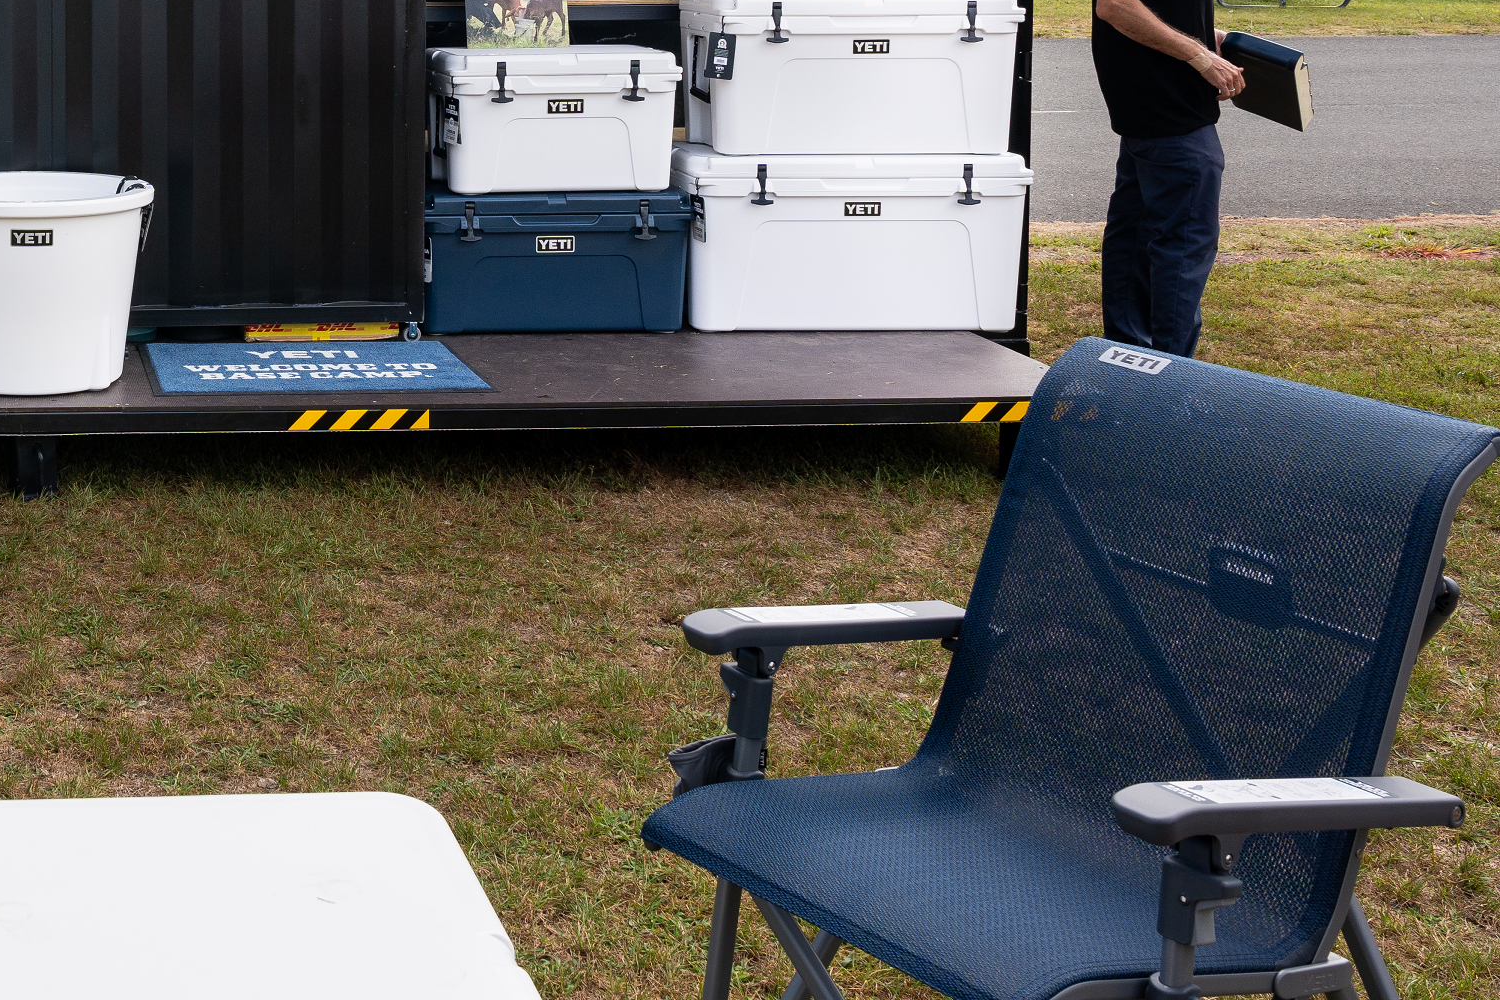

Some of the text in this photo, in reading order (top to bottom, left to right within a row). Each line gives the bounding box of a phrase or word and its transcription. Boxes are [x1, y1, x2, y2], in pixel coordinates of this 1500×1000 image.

[854, 41, 888, 53] YETI
[549, 101, 582, 112] YETI
[846, 204, 879, 215] YETI
[13, 232, 51, 244] YETI
[538, 240, 573, 249] YETI
[315, 323, 357, 332] DHL
[246, 350, 359, 359] YETI
[1109, 349, 1160, 370] YETI
[183, 363, 438, 372] WELCOME TO
[200, 371, 434, 380] BASE CAMP.
